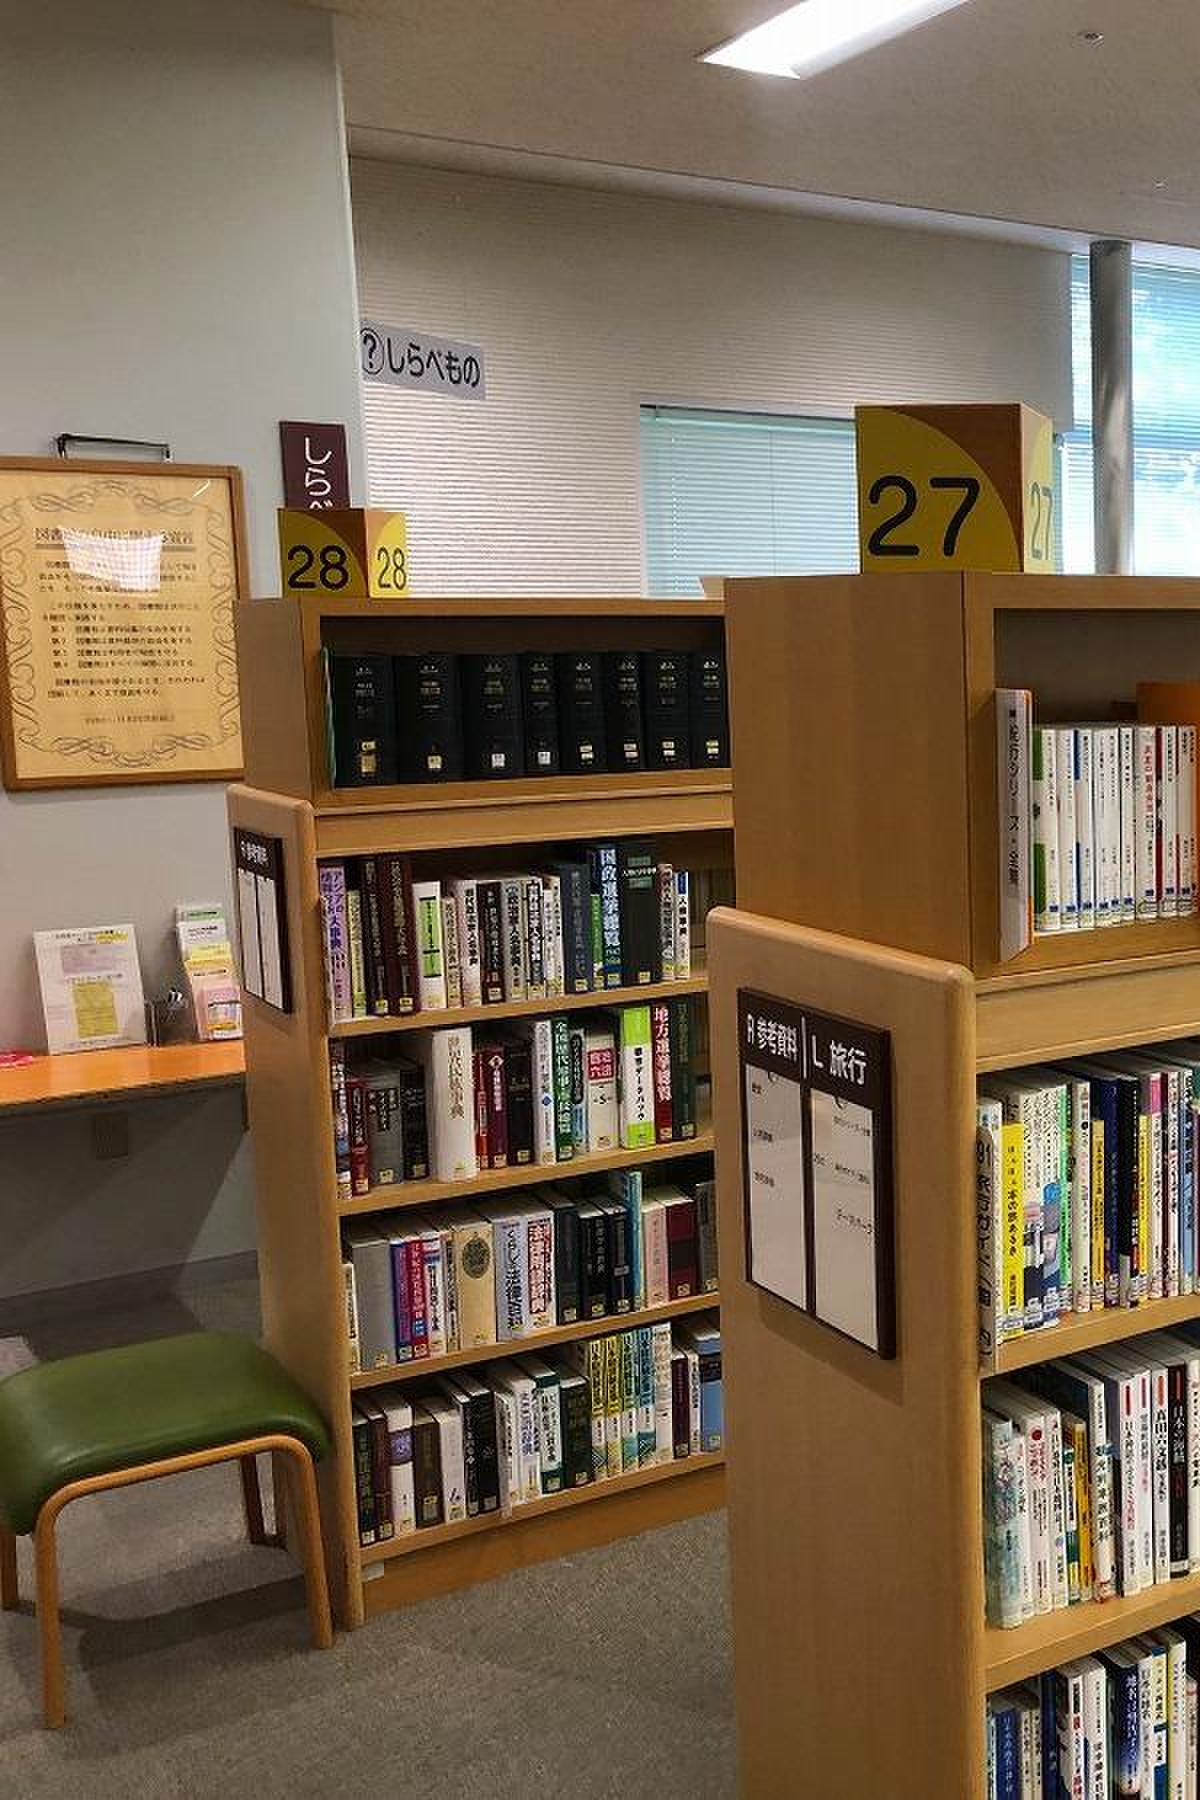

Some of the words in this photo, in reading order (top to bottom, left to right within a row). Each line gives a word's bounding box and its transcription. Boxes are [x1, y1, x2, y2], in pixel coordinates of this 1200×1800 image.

[385, 341, 481, 388] しらべもの
[867, 475, 980, 557] 27
[1030, 481, 1052, 561] 27
[287, 544, 350, 591] 28
[376, 546, 408, 590] 28
[829, 1039, 867, 1086] 旅行
